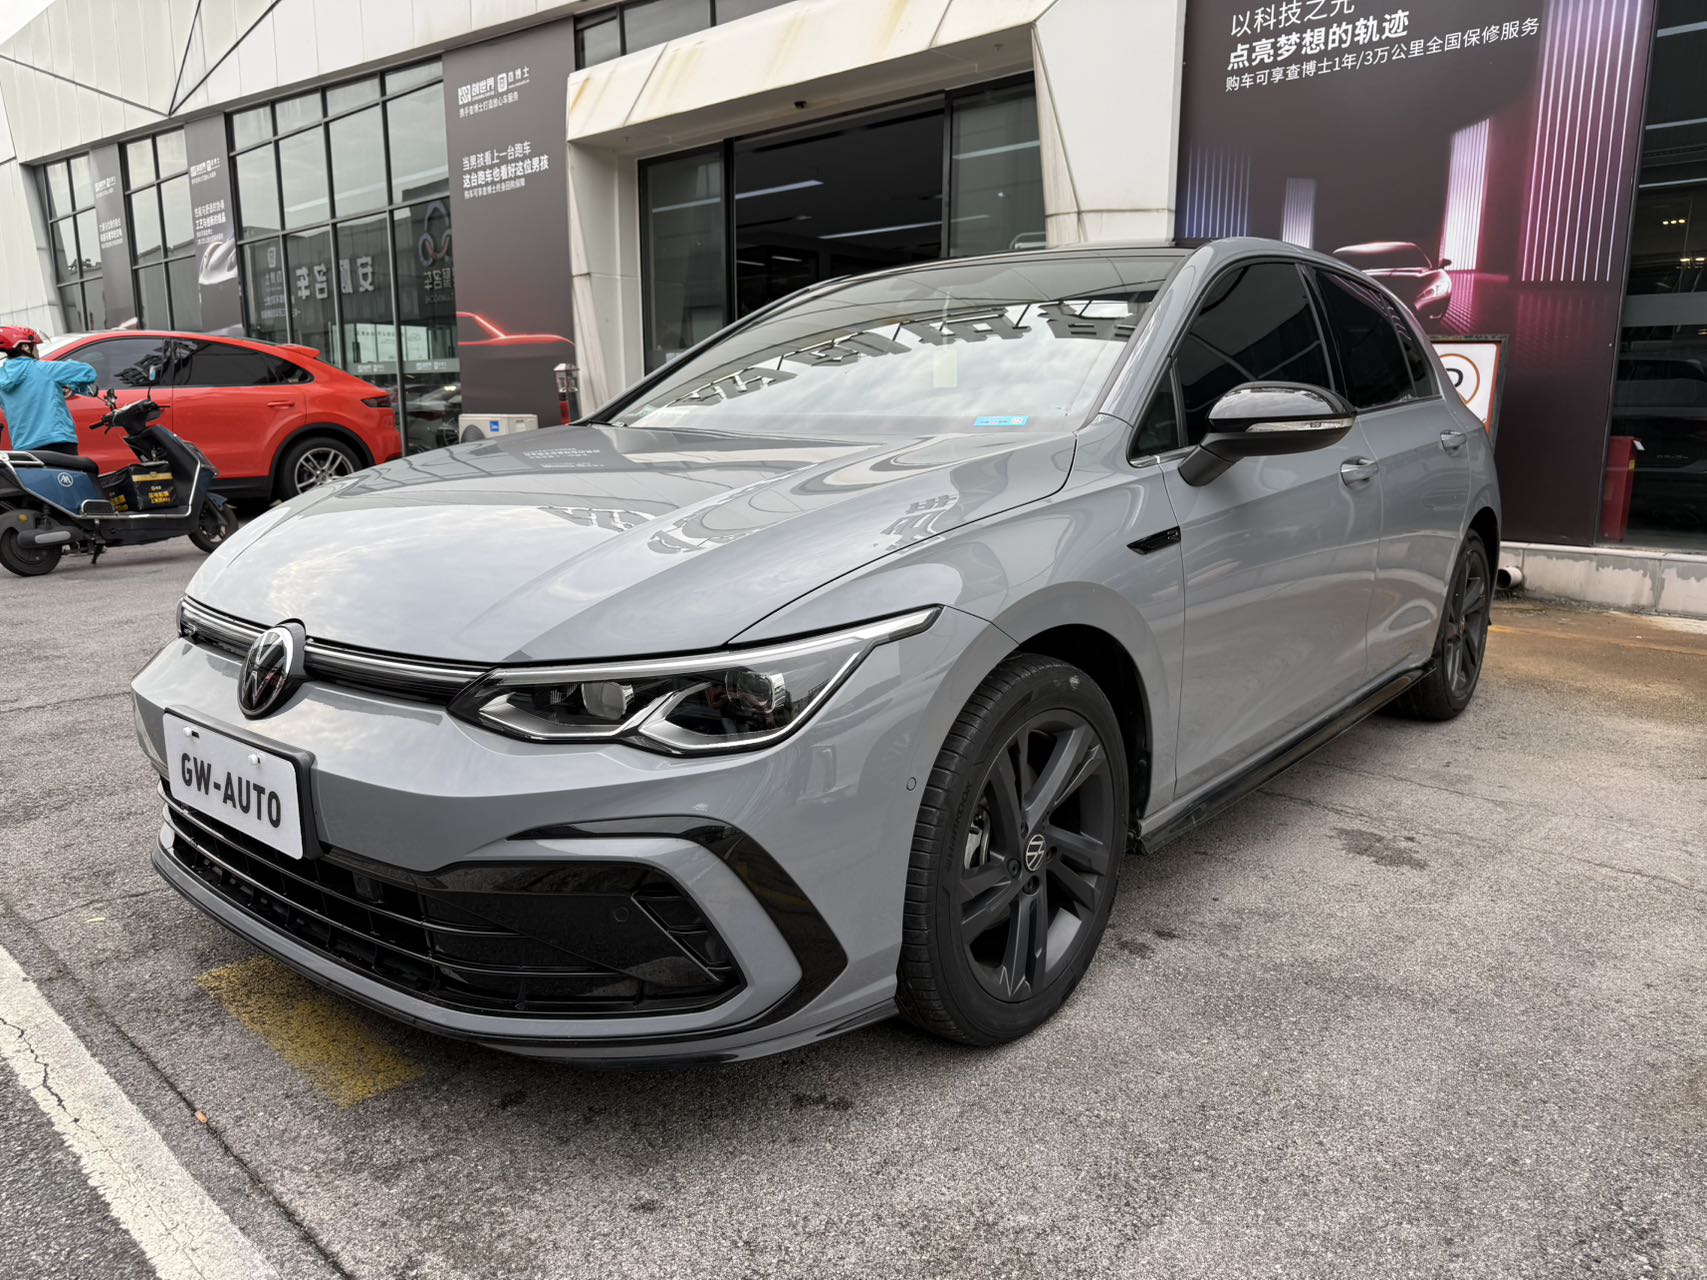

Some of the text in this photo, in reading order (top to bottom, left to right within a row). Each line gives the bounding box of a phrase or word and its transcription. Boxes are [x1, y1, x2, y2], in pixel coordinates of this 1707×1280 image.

[1226, 17, 1539, 92] 购车可享查博士1年/3万公里全国保修服务
[1227, 10, 1409, 71] 点亮梦想的轨迹
[462, 141, 531, 171] 当男孩看上一台跑车
[463, 154, 549, 188] 这台跑车也看好这位男孩
[181, 753, 281, 829] GW-AUTO
